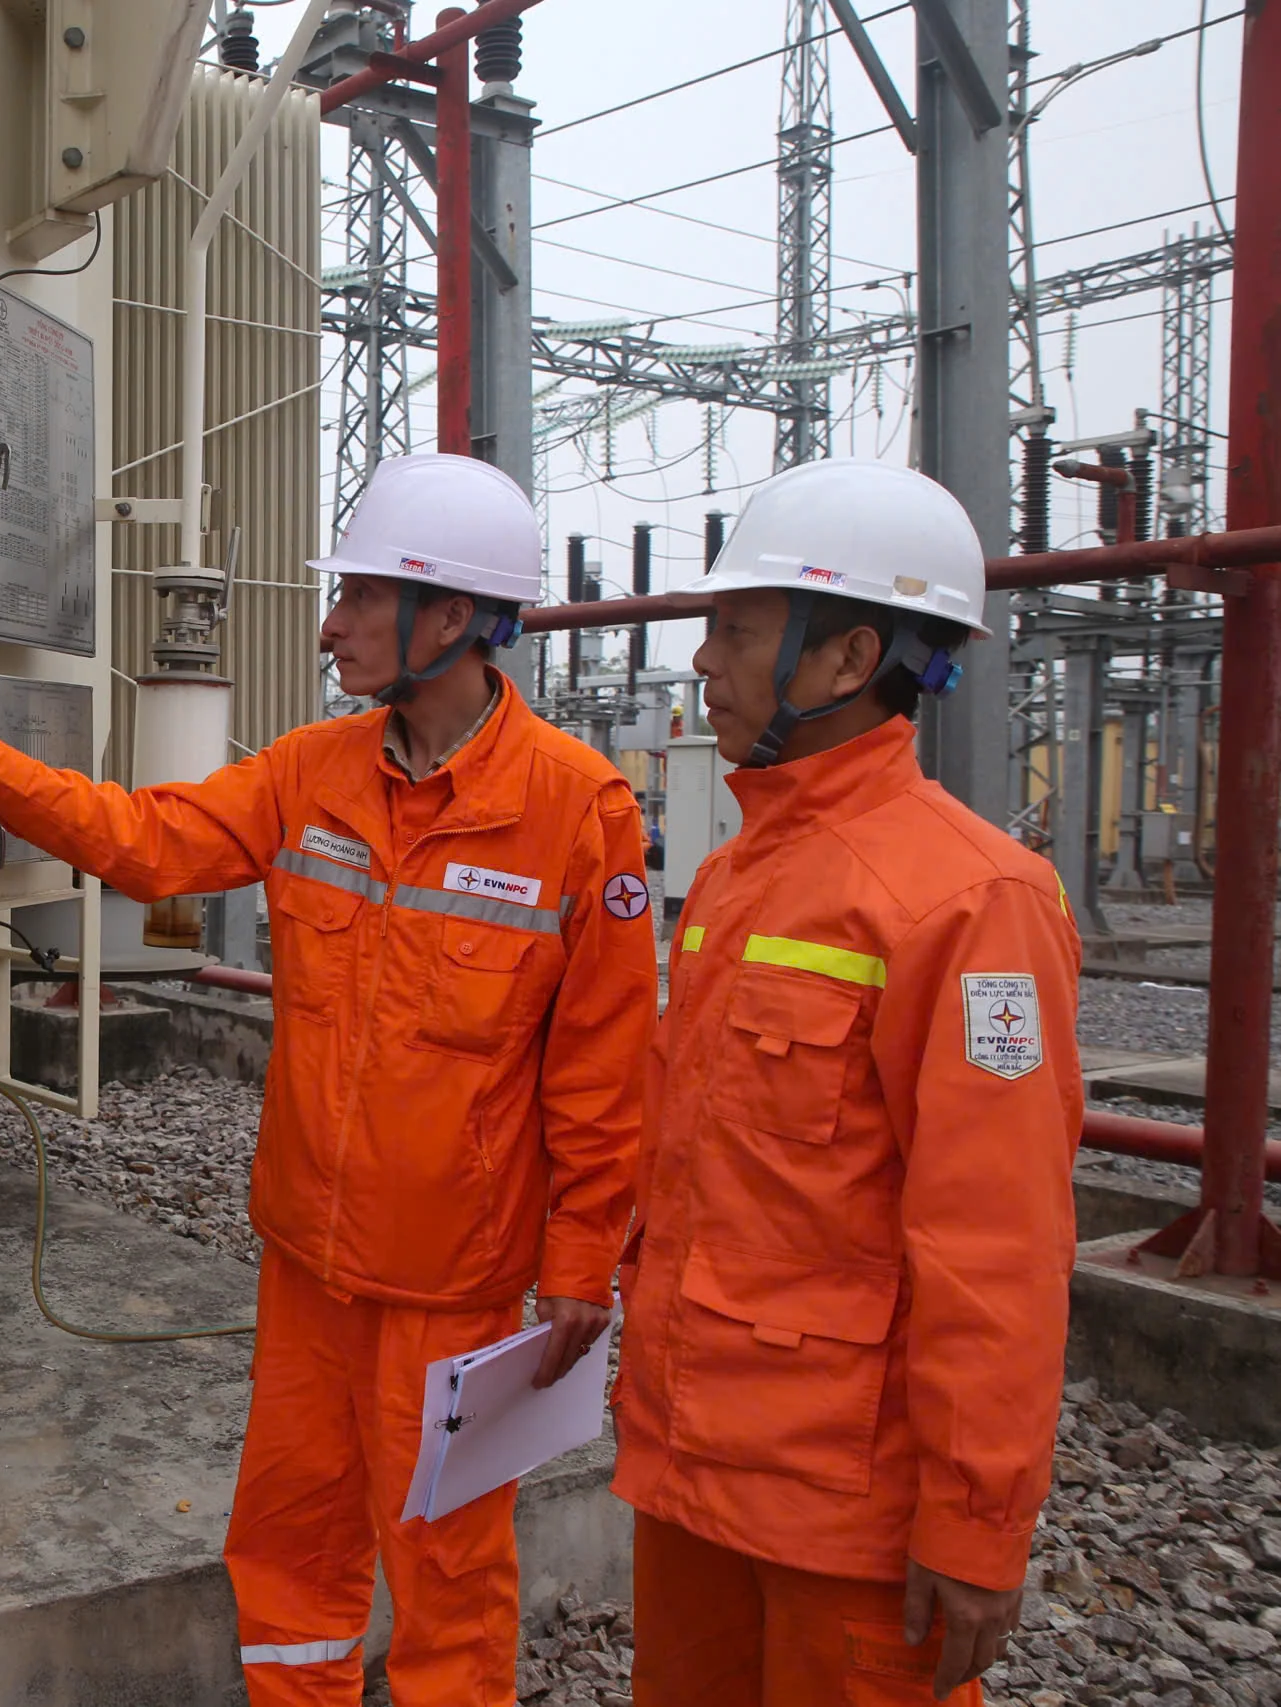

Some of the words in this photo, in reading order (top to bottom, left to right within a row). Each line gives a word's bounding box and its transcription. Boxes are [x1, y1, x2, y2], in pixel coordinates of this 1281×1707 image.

[483, 878, 528, 894] EVNNPC
[999, 979, 1018, 990] CÔNG
[977, 1036, 1035, 1045] EVNNPC
[996, 1045, 1027, 1053] NGC
